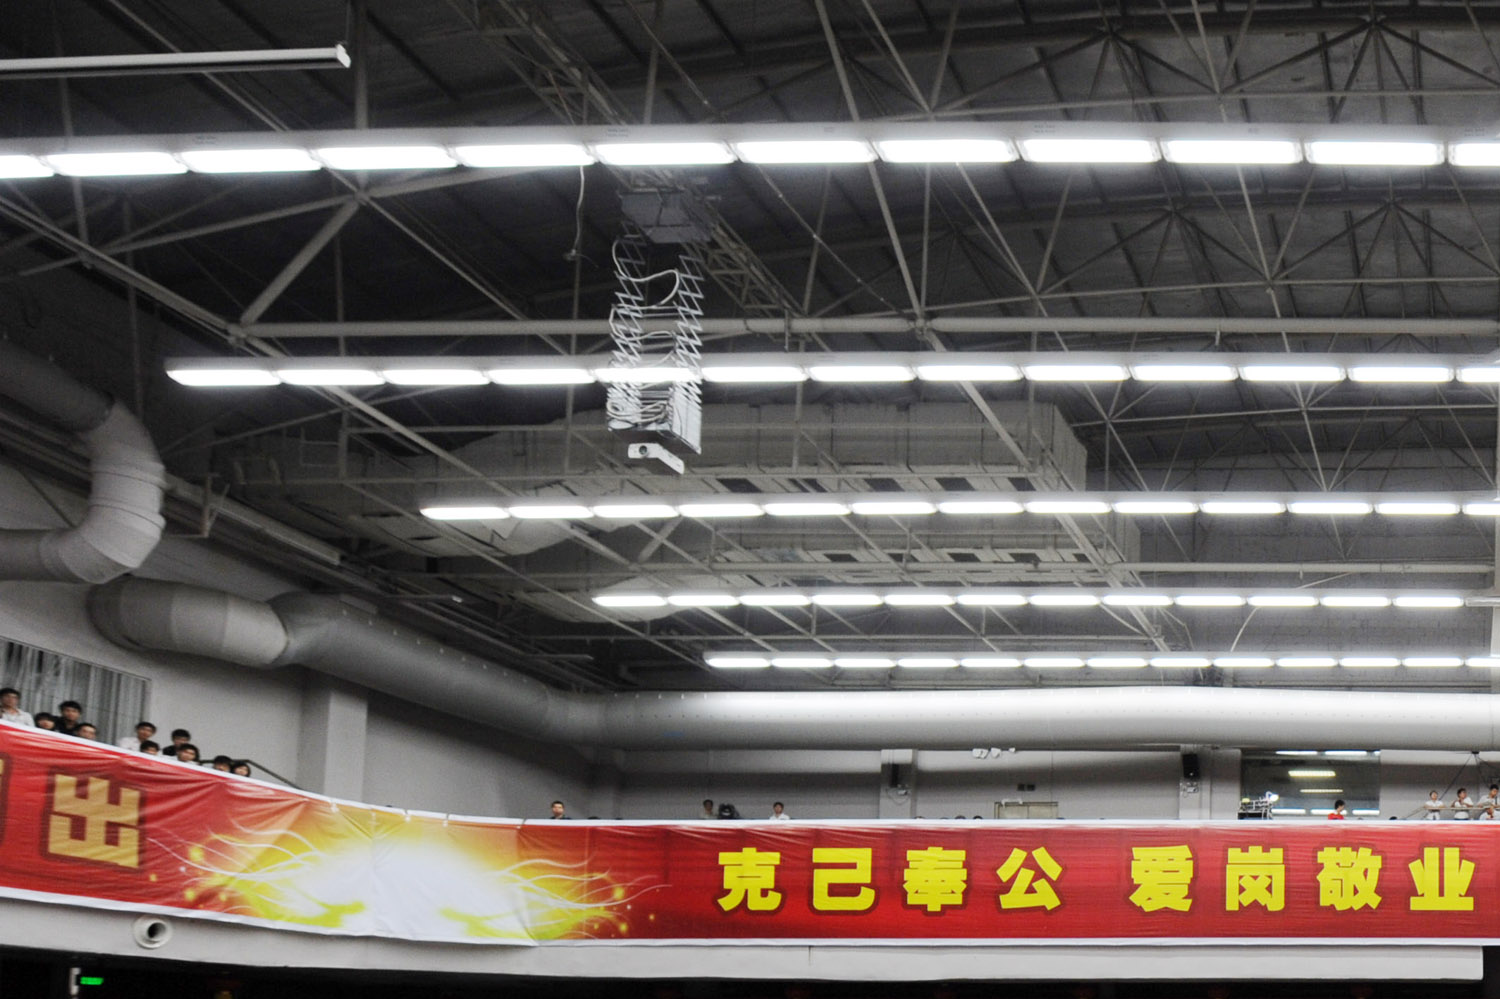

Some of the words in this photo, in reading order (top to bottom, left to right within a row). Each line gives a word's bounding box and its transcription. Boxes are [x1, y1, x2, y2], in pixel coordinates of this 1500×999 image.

[719, 847, 1064, 913] 克己奉公
[1130, 846, 1477, 913] 爱岗敬业
